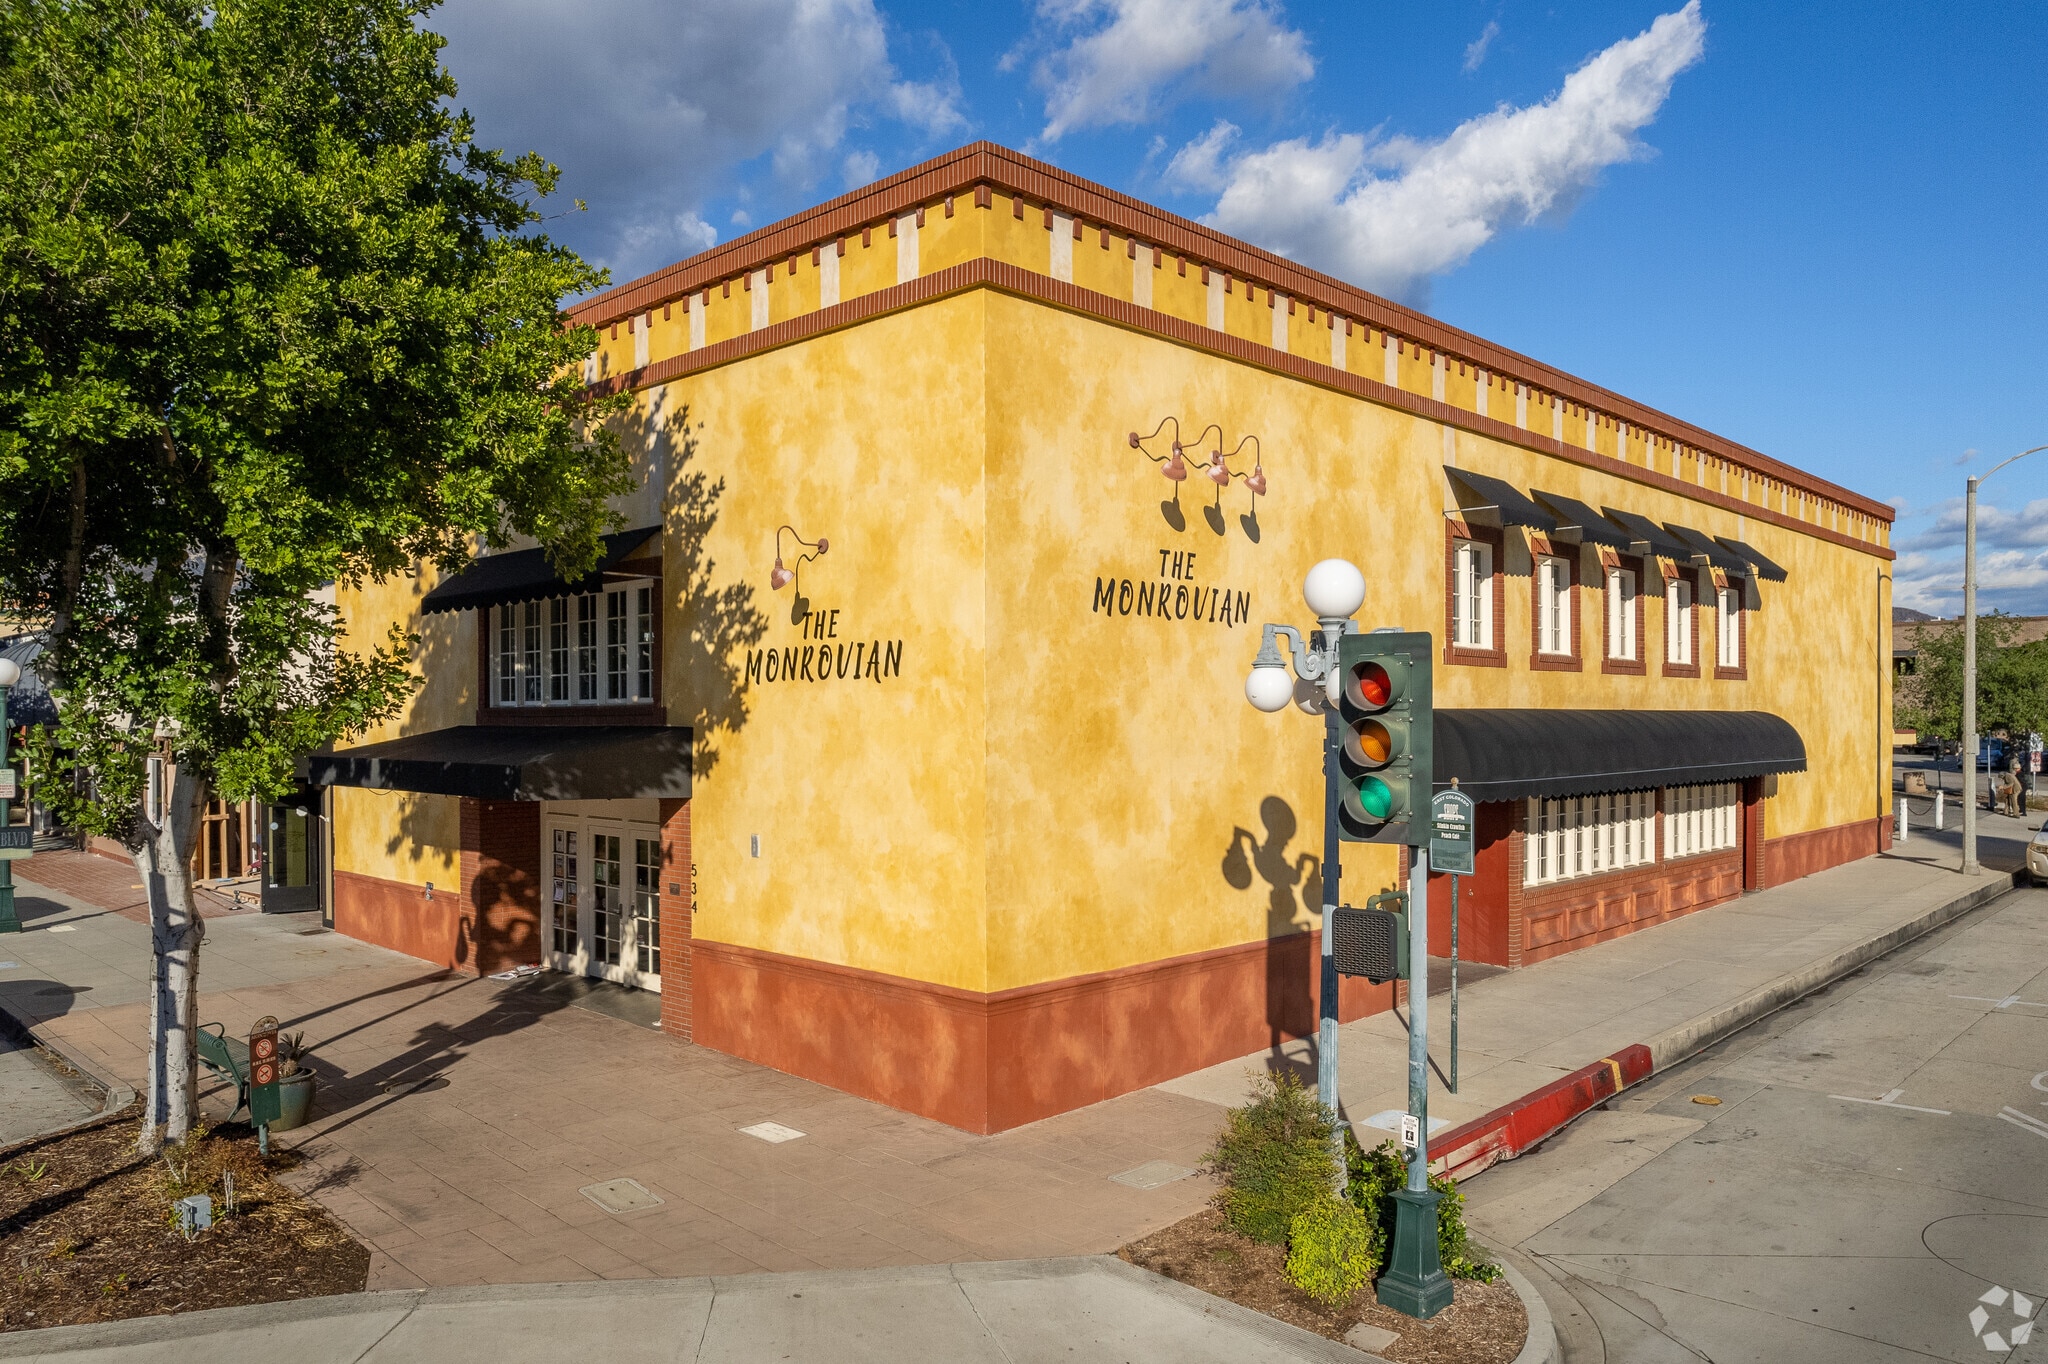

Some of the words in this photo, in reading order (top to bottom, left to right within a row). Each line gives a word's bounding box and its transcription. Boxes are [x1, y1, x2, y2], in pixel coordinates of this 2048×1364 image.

[1159, 549, 1196, 580] THE
[1093, 576, 1250, 628] MONROVIAN
[802, 609, 840, 640] THE
[745, 639, 903, 685] MONROVIAN
[1446, 794, 1470, 807] COLORADO
[0, 831, 28, 847] BLVD
